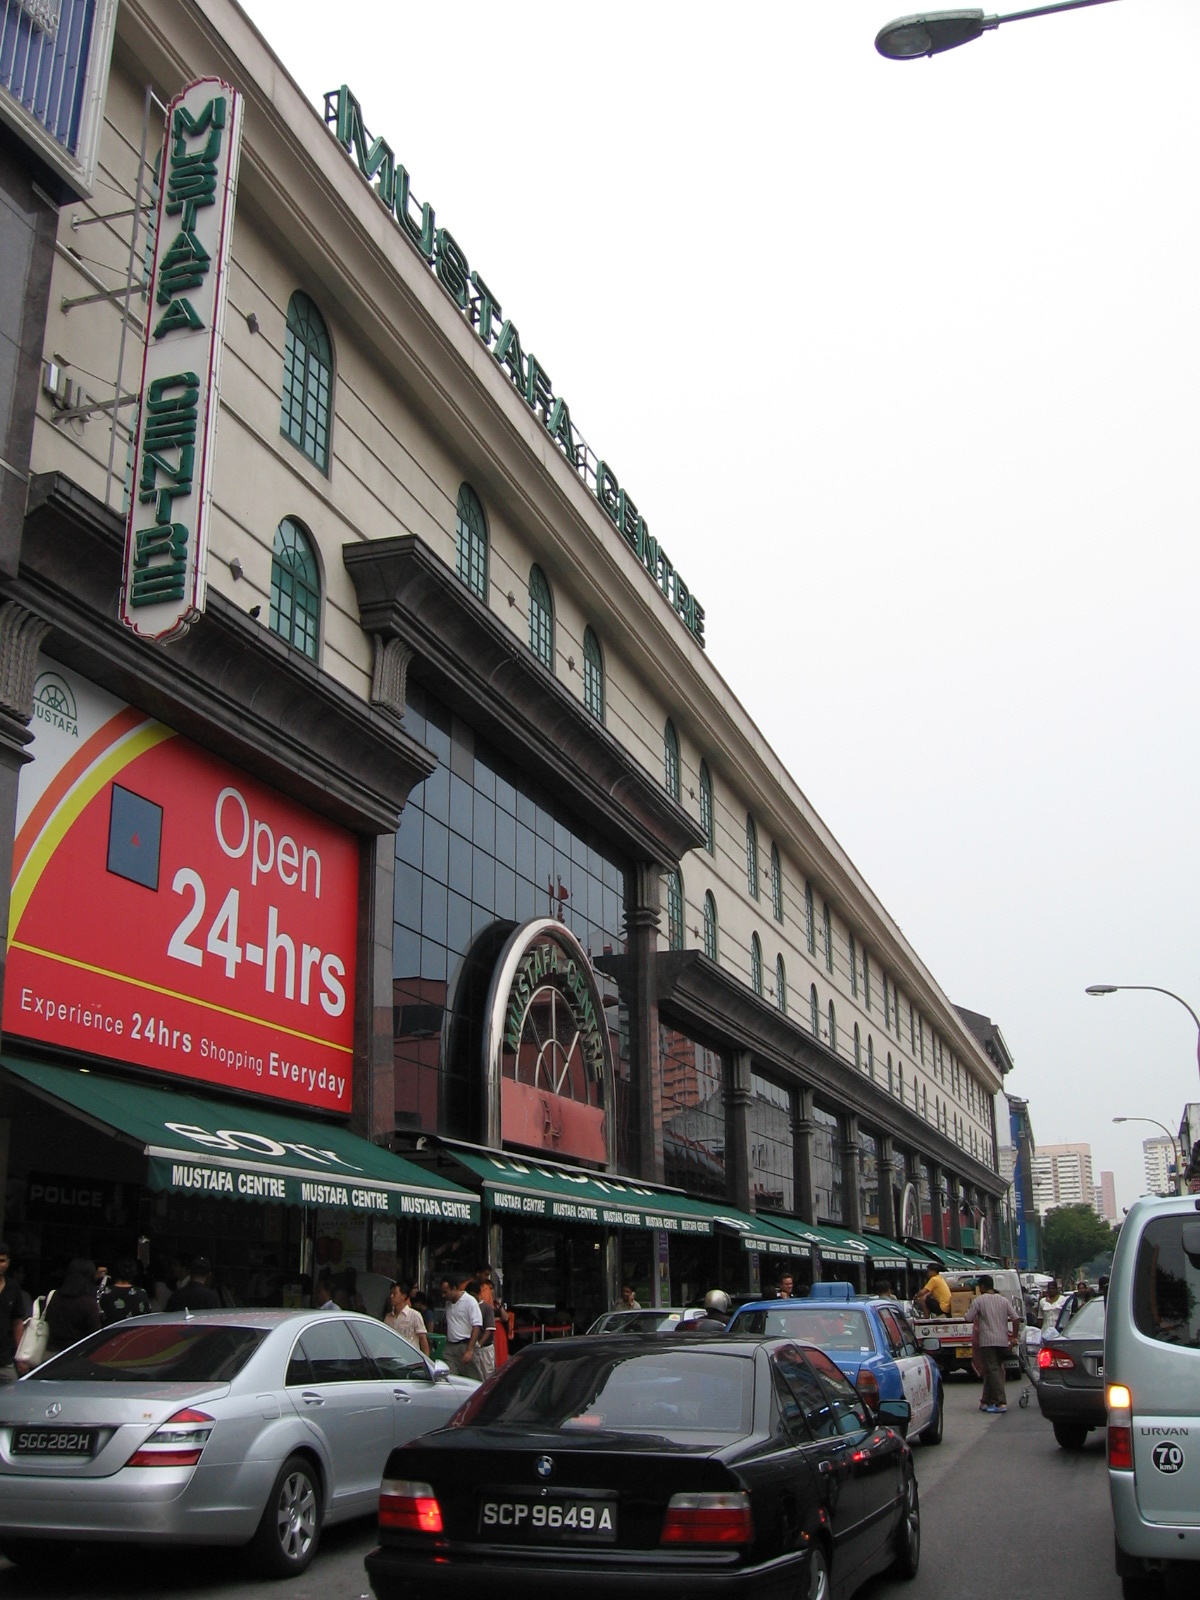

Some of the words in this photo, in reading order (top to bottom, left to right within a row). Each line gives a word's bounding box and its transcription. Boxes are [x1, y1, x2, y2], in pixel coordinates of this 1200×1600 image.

[152, 96, 226, 340] MUSTAFA
[336, 84, 578, 468] MUSTAFA
[596, 460, 706, 650] CENTRE
[129, 371, 200, 608] CENTRE
[214, 786, 322, 899] Open
[166, 867, 347, 1018] 24-hrs
[20, 987, 124, 1035] Experience
[130, 1012, 193, 1054] 24hrs
[200, 1038, 264, 1077] Shopping
[269, 1052, 346, 1099] Everyday
[506, 943, 559, 1054] MUSTAFA
[30, 1184, 104, 1208] POLICE
[172, 1165, 234, 1193] MUSTAFA
[238, 1174, 286, 1198] CENTRE
[301, 1182, 349, 1206] MUSTAFA
[351, 1189, 389, 1210] CENTRE
[400, 1195, 442, 1216] MUSTAFA
[441, 1201, 471, 1220] CENTRE
[493, 1191, 521, 1210] MUSTAFA
[522, 1197, 545, 1214] CENTRE
[552, 1202, 576, 1218] MUSTAFA
[577, 1205, 598, 1221] CENTRE
[18, 1433, 89, 1449] SGG282H
[1140, 1427, 1189, 1436] URVAN
[1155, 1447, 1182, 1464] 70
